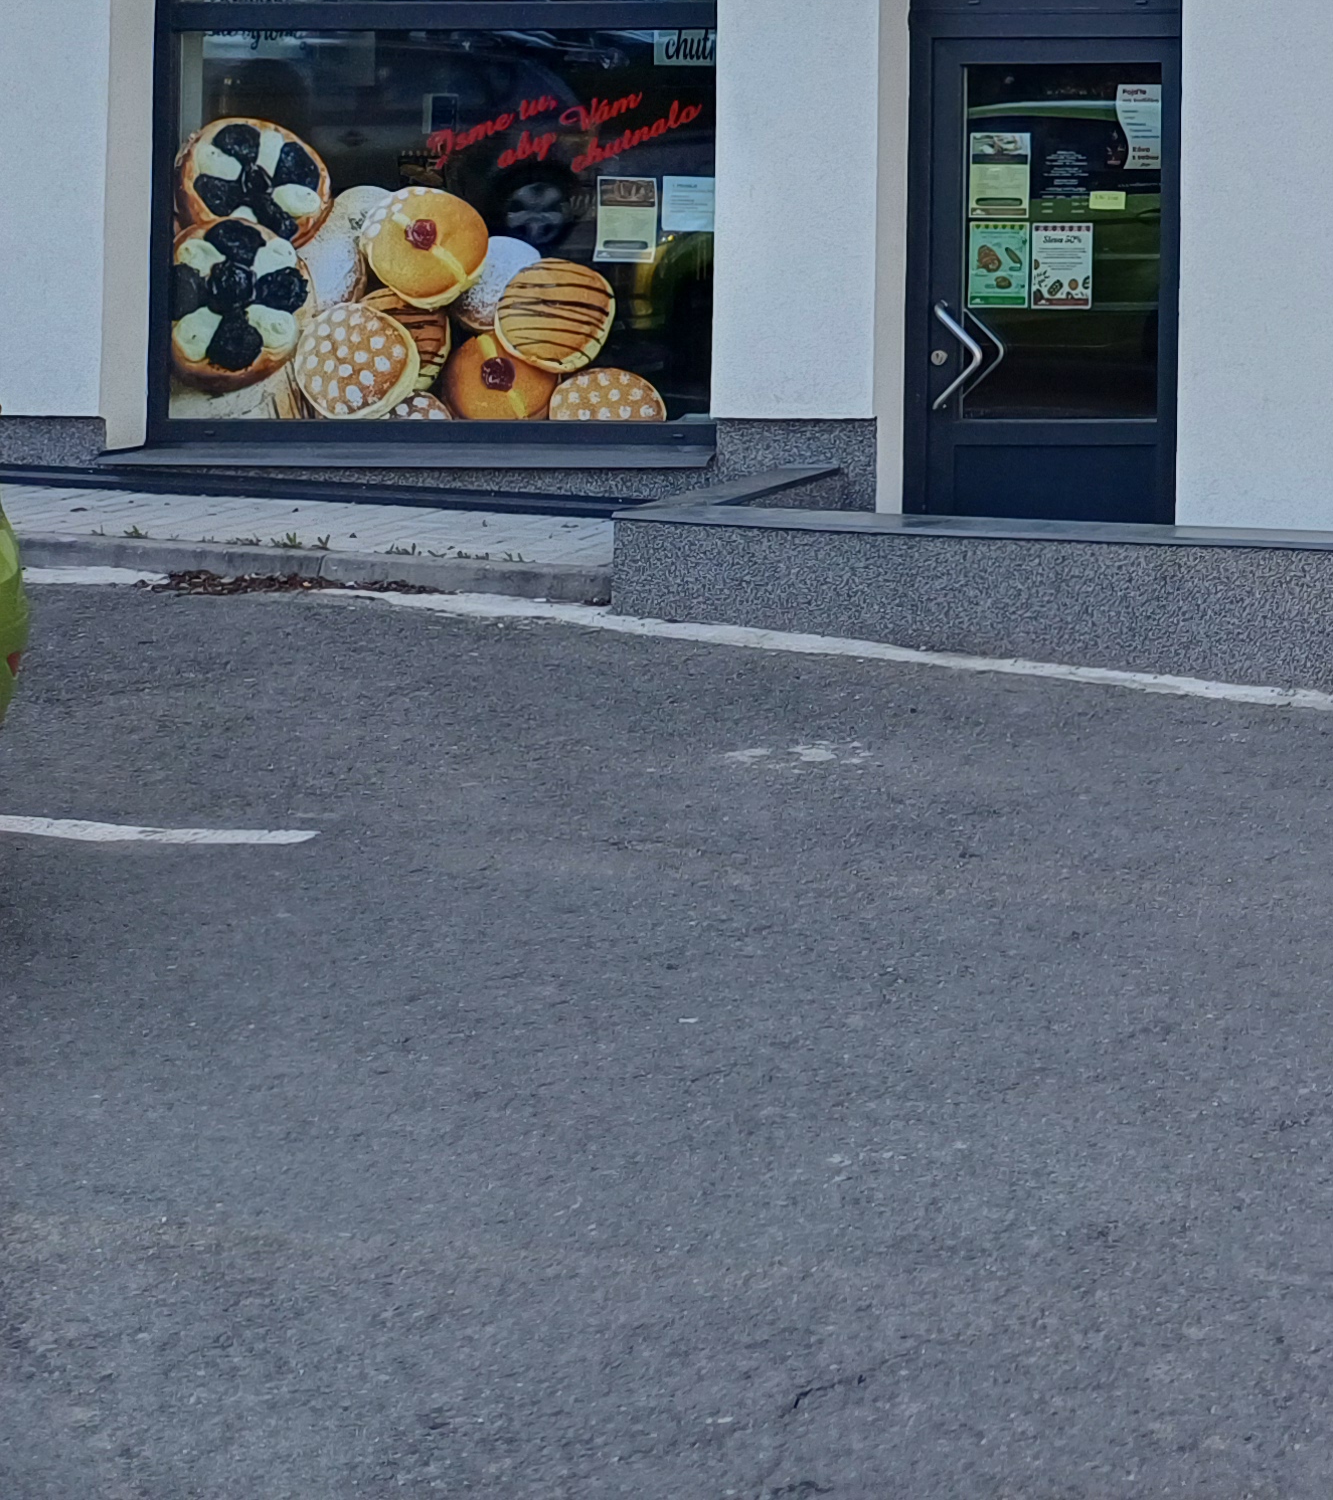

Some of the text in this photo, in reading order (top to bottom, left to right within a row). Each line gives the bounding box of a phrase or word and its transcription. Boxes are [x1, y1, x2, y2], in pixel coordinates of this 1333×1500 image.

[497, 92, 643, 168] aby Vám
[571, 100, 702, 173] chutnalo
